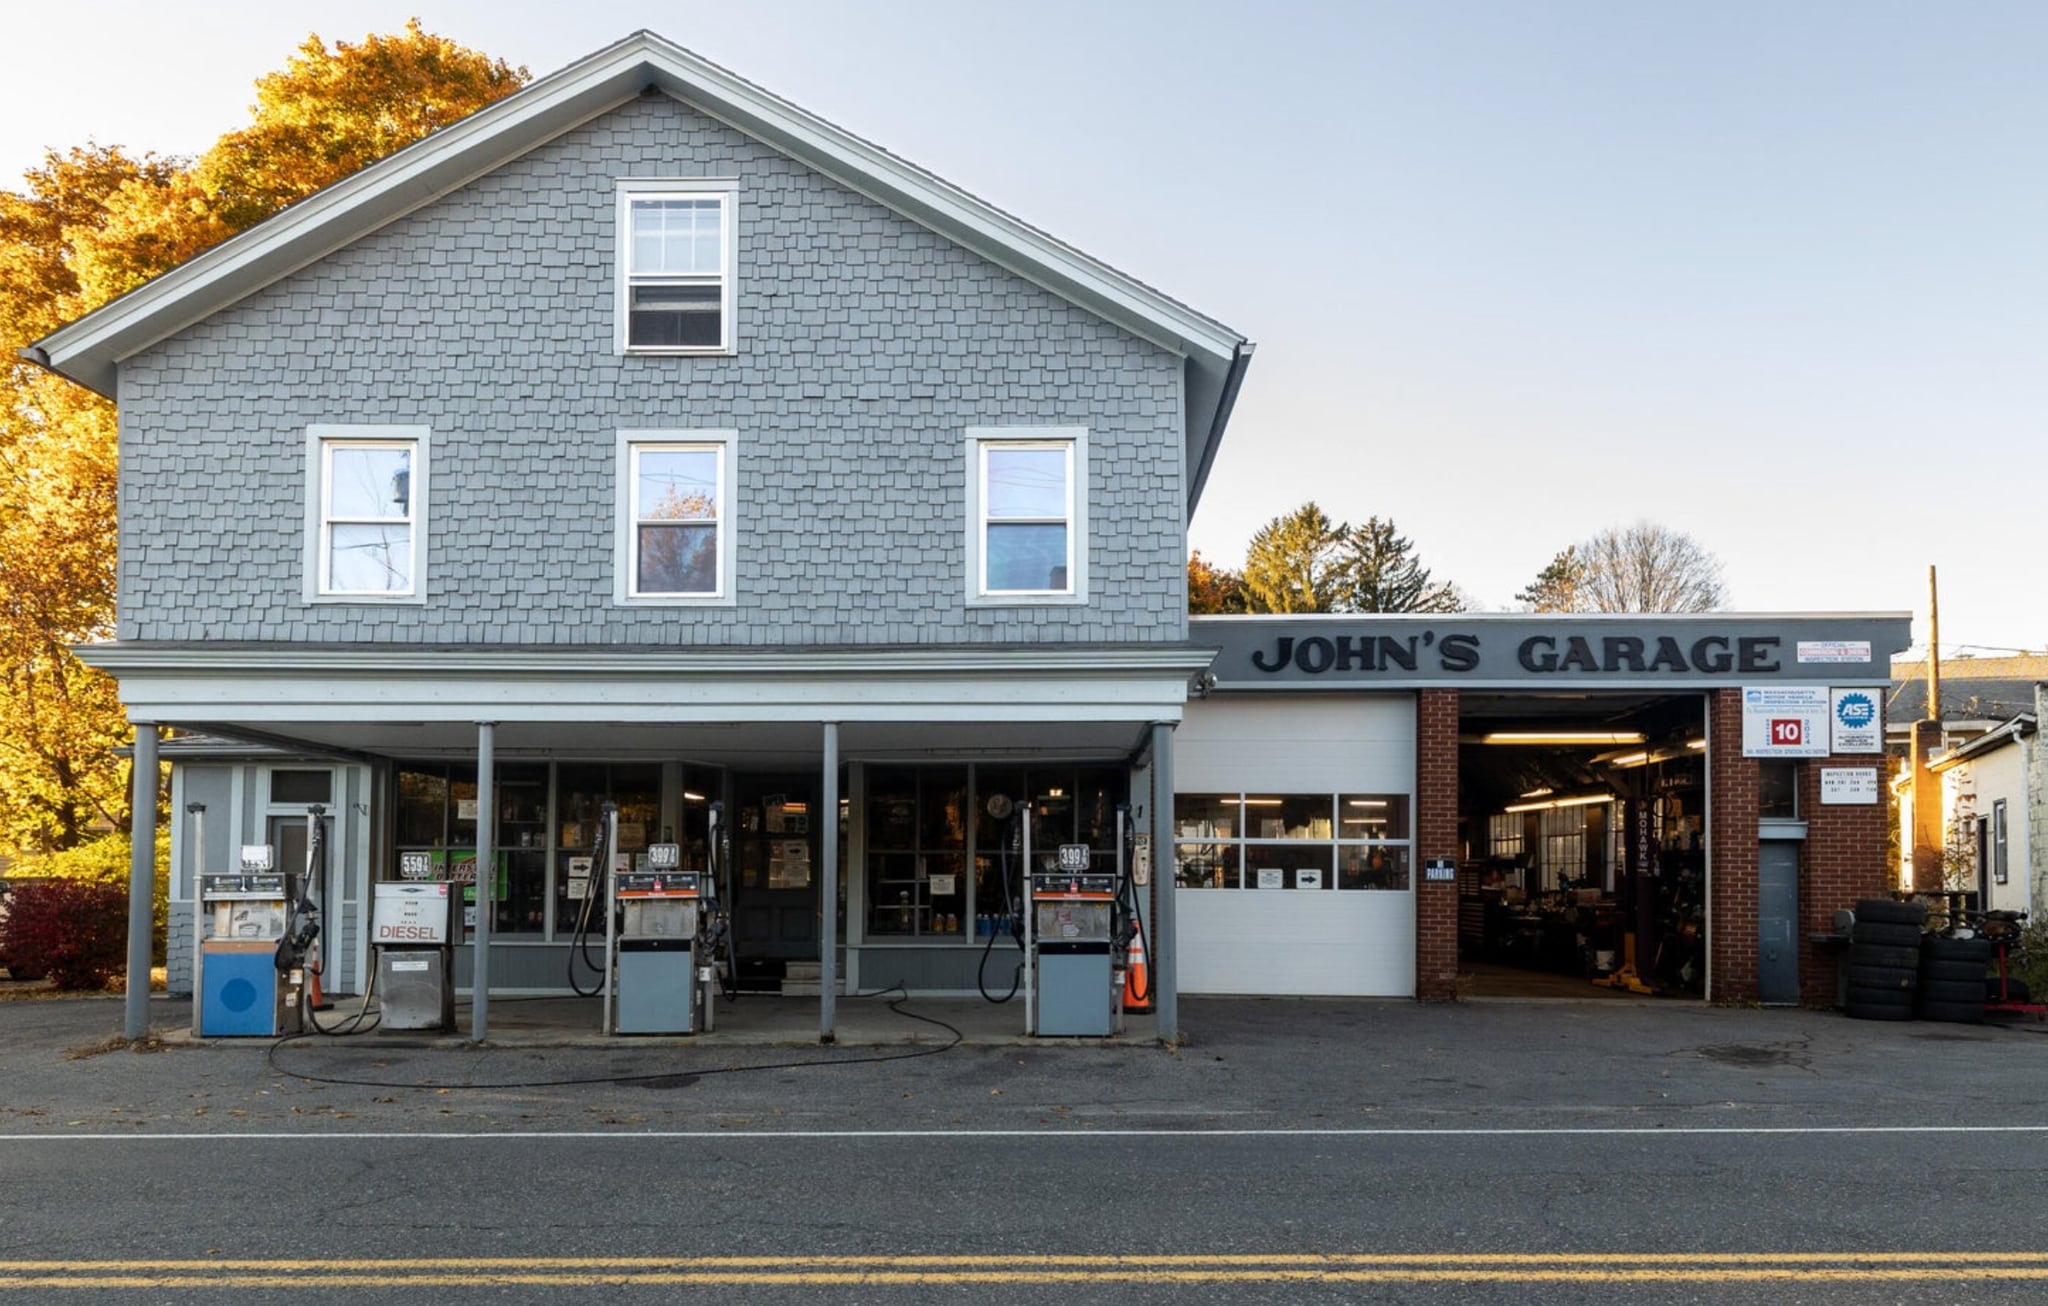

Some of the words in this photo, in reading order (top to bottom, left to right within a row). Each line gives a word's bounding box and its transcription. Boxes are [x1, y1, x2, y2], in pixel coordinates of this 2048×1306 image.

[1252, 630, 1480, 673] JOHN'S
[1517, 636, 1781, 673] GARAGE
[1841, 703, 1869, 716] ASE
[1775, 723, 1799, 740] 10
[1639, 811, 1648, 860] MOHAWK
[1426, 868, 1454, 880] PARKING
[380, 925, 439, 941] DIESEL
